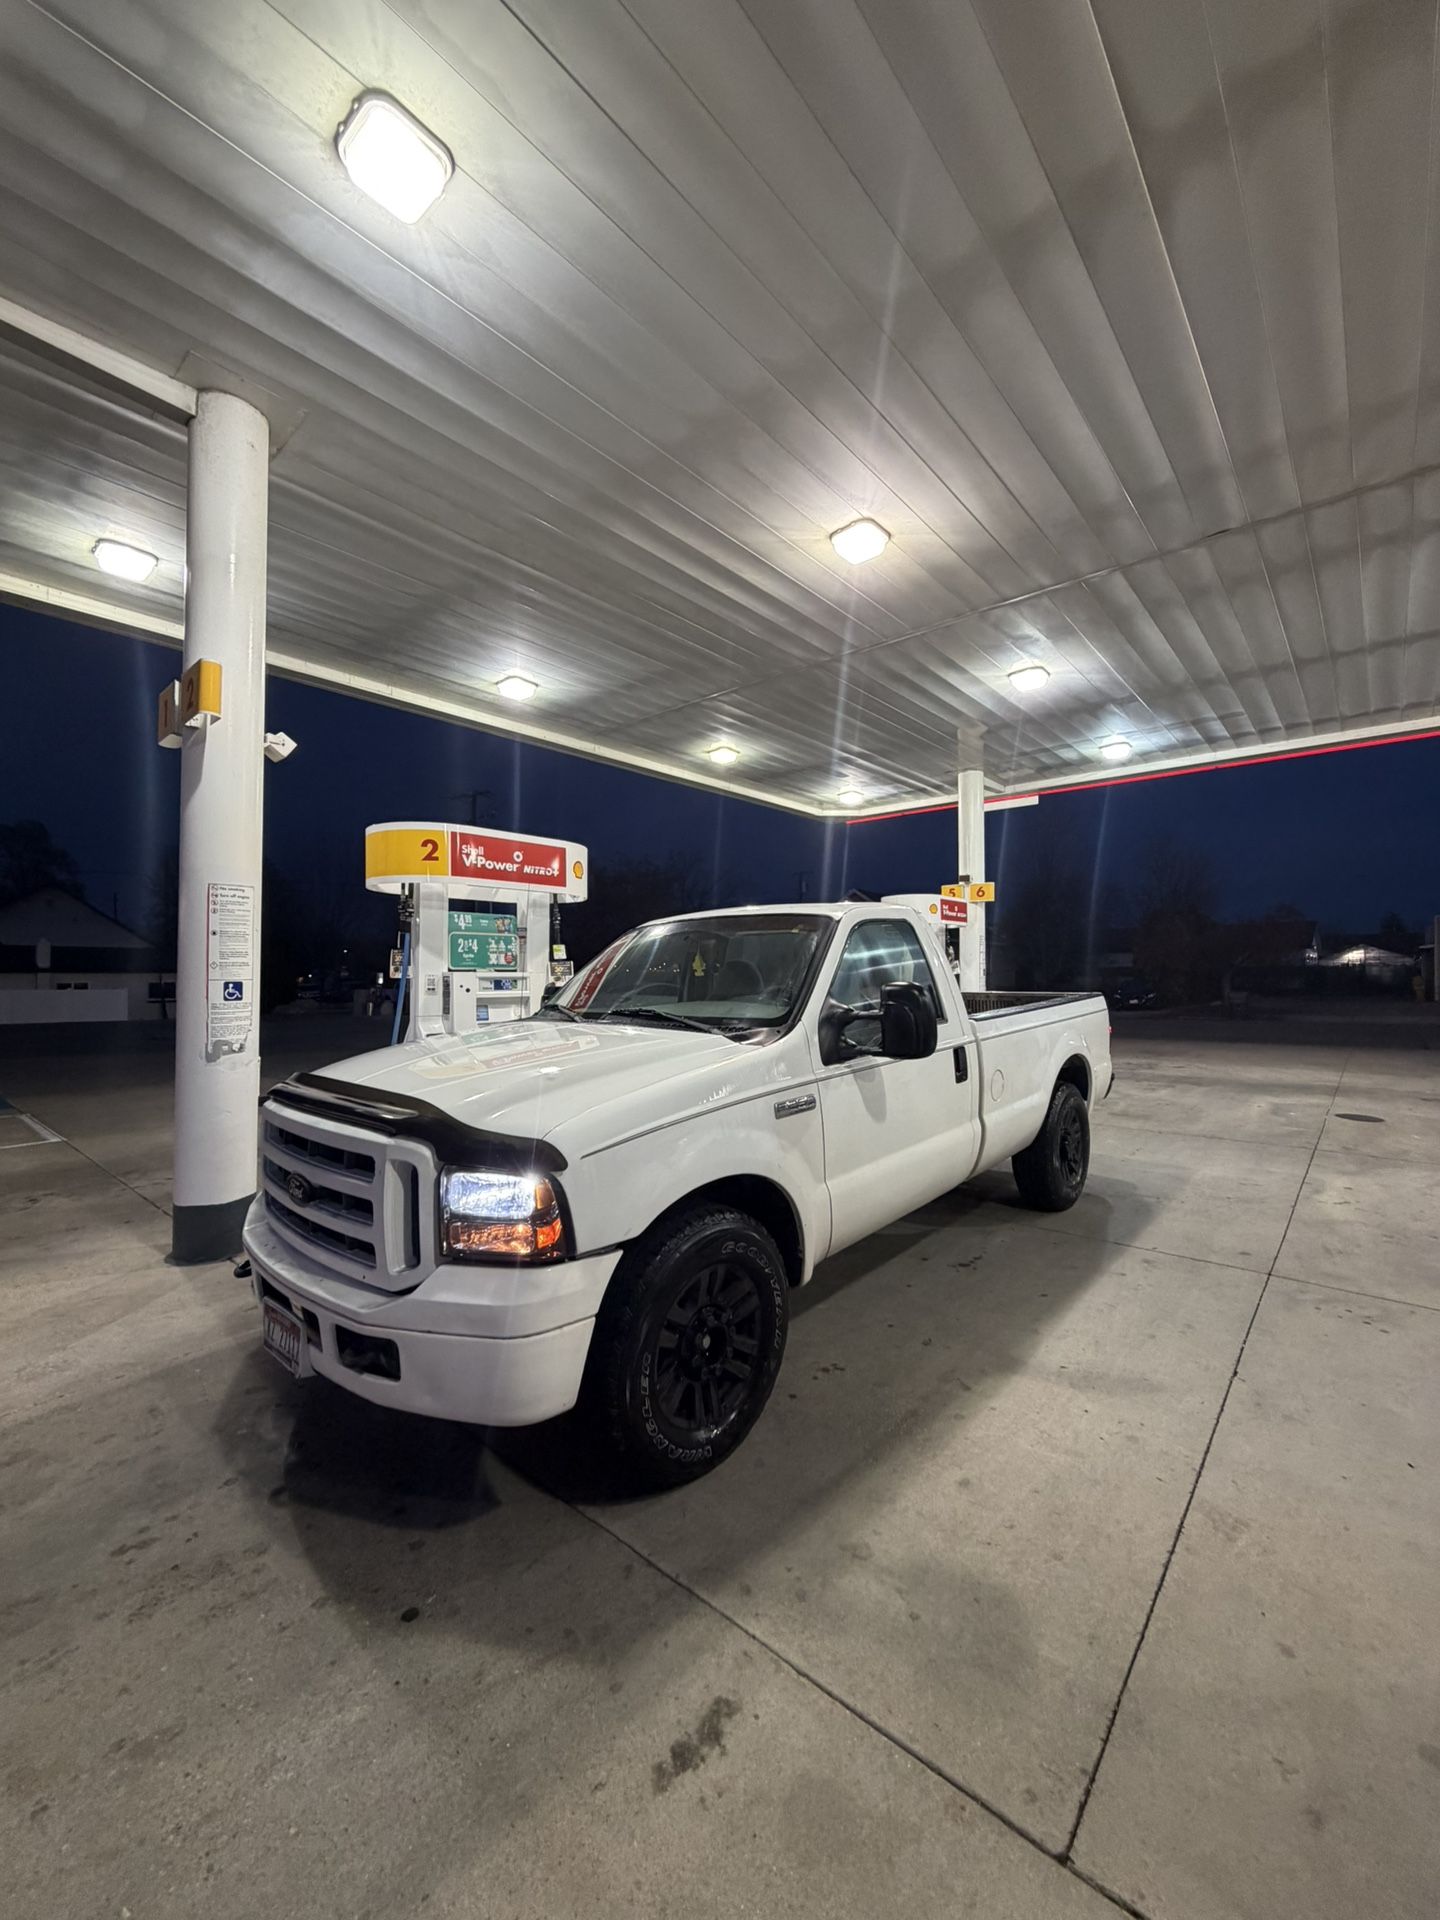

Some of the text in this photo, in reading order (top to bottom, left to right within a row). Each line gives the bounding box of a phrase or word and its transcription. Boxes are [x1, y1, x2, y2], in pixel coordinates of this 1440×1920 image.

[186, 677, 195, 711] 2
[420, 838, 440, 862] 2
[948, 888, 956, 897] 5
[976, 886, 985, 898] 6
[457, 938, 464, 953] 2
